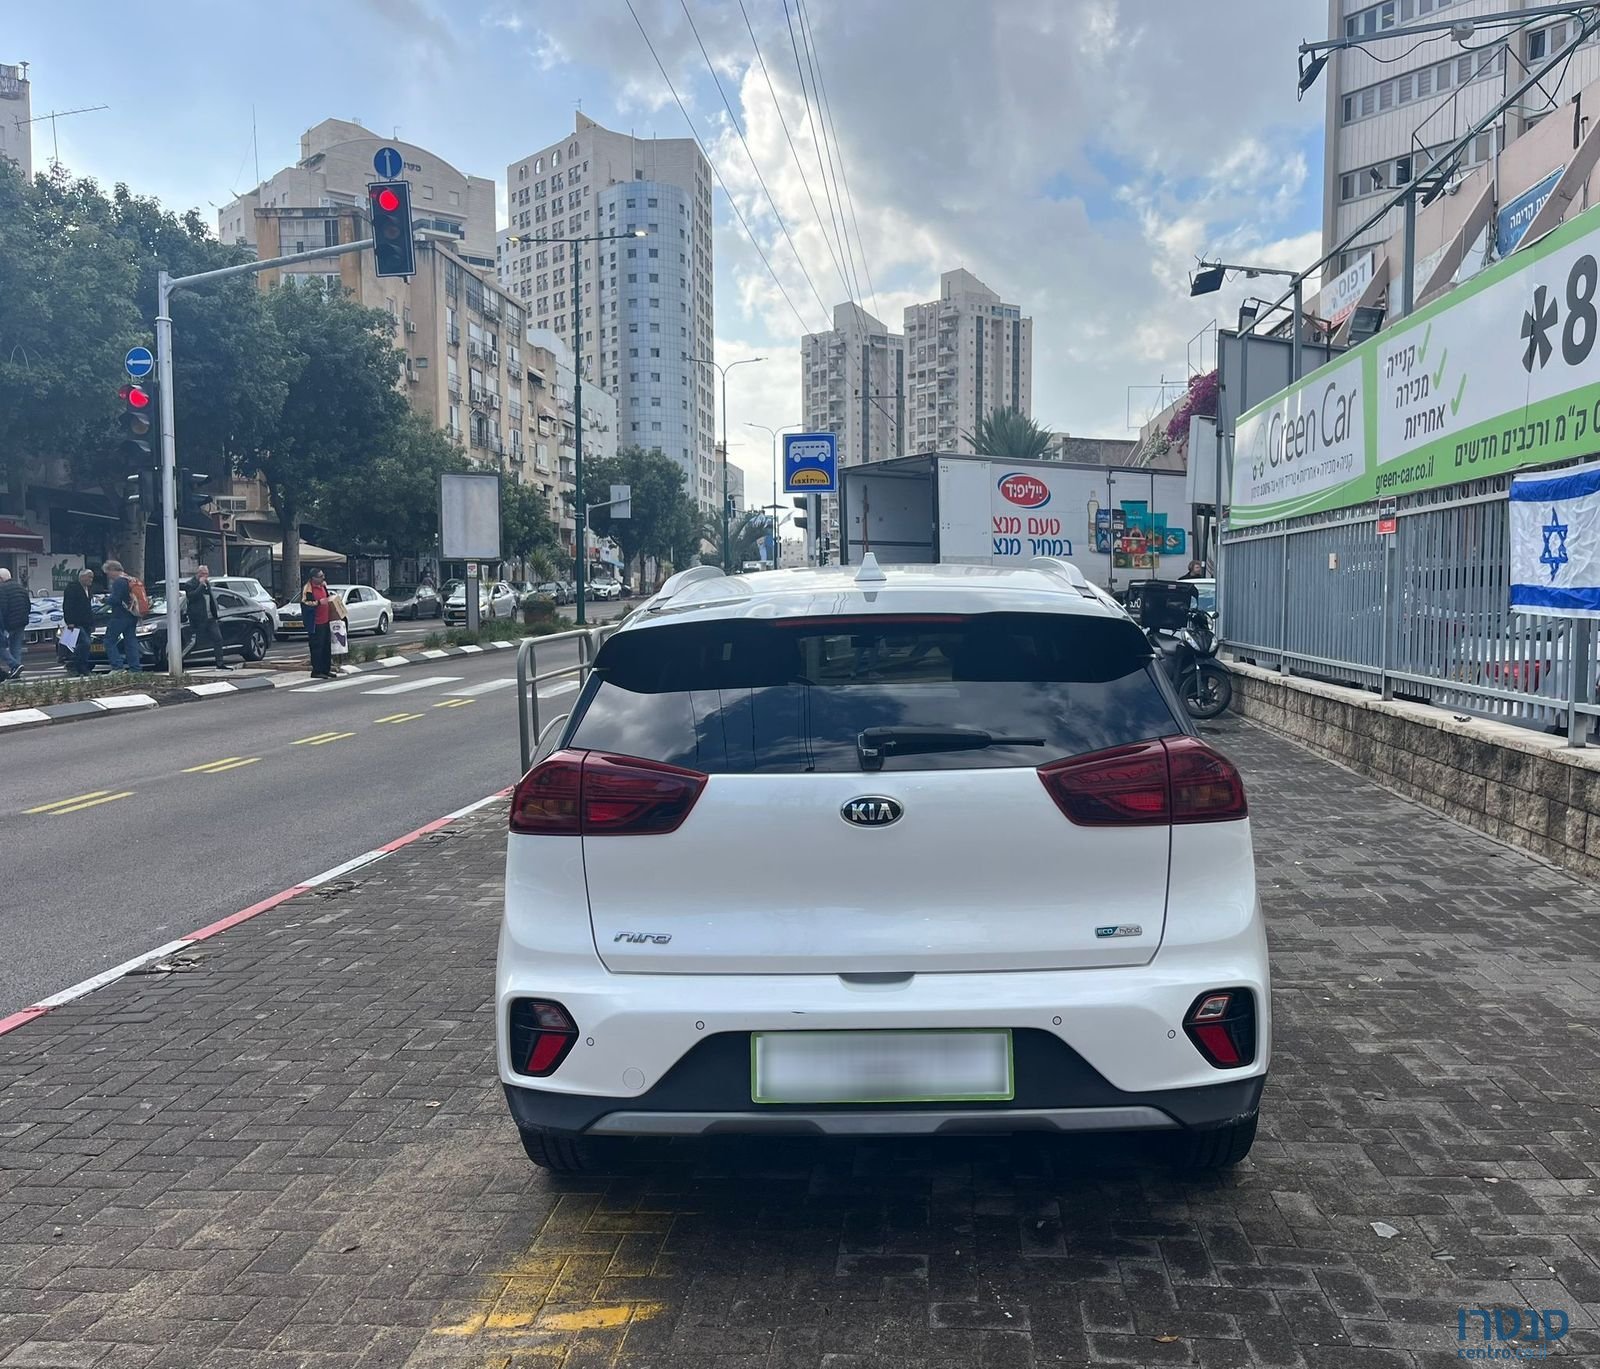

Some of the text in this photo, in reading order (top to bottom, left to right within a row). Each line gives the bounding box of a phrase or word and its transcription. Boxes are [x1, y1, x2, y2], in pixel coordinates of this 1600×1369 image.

[1338, 262, 1367, 298] דפוס
[1386, 344, 1415, 379] קנייה
[1395, 374, 1429, 409] מכירה
[1269, 381, 1357, 468] Green Car
[1403, 403, 1446, 441] אחריות
[1501, 419, 1550, 456] ורכבים
[1454, 434, 1498, 467] חדשים
[1375, 455, 1435, 495] green-car.co.il
[1028, 517, 1060, 536] טעם
[1027, 538, 1073, 557] במחיר
[851, 802, 894, 821] KIA
